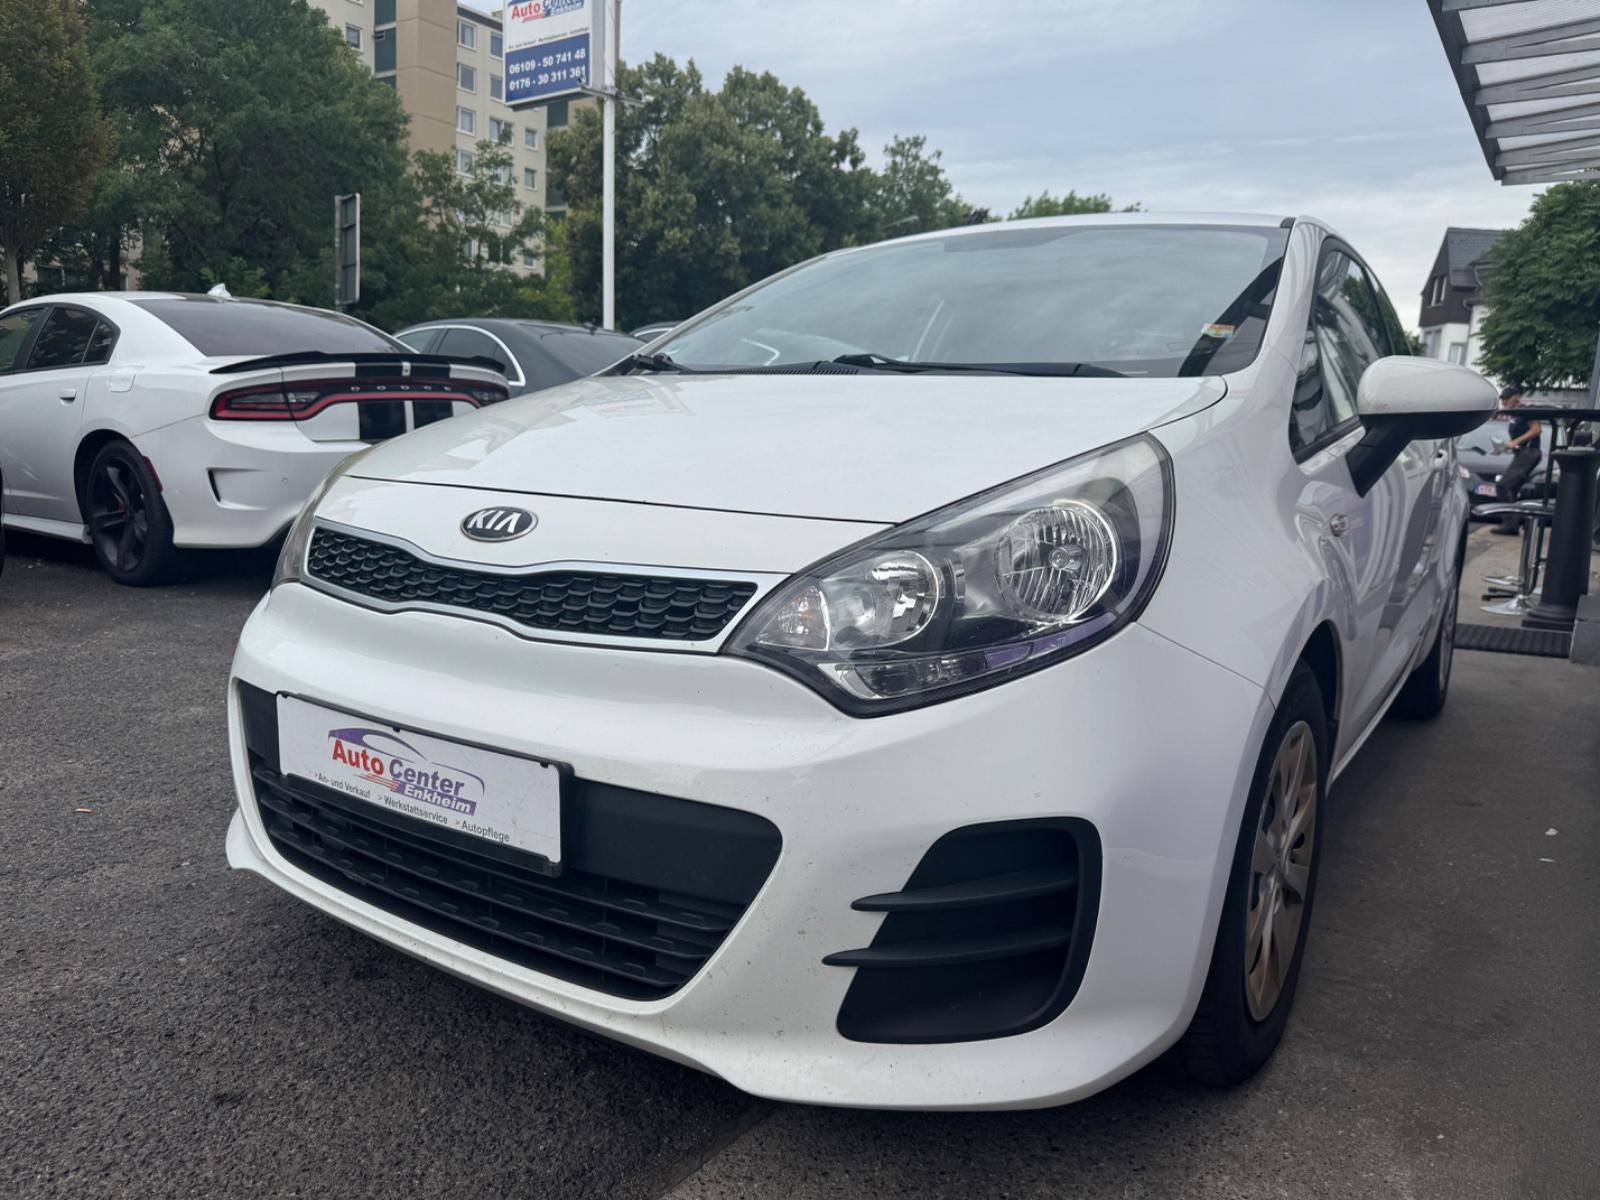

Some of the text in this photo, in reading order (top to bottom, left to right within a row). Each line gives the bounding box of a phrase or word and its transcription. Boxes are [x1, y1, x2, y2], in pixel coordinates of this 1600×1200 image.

[511, 2, 541, 20] Auto
[508, 59, 537, 75] 06109
[542, 55, 554, 68] 50
[555, 51, 572, 65] 741
[574, 47, 586, 60] 48
[509, 76, 531, 91] 0176
[537, 73, 549, 85] 30
[550, 69, 567, 82] 311
[569, 65, 586, 78] 361
[466, 509, 522, 534] KIA
[332, 739, 465, 796] Auto Center
[331, 779, 344, 790] und
[344, 781, 371, 799] Verkauf
[383, 794, 448, 825] Werkstattservice
[461, 820, 511, 846] Autopflege
[404, 783, 472, 814] Enkheim
